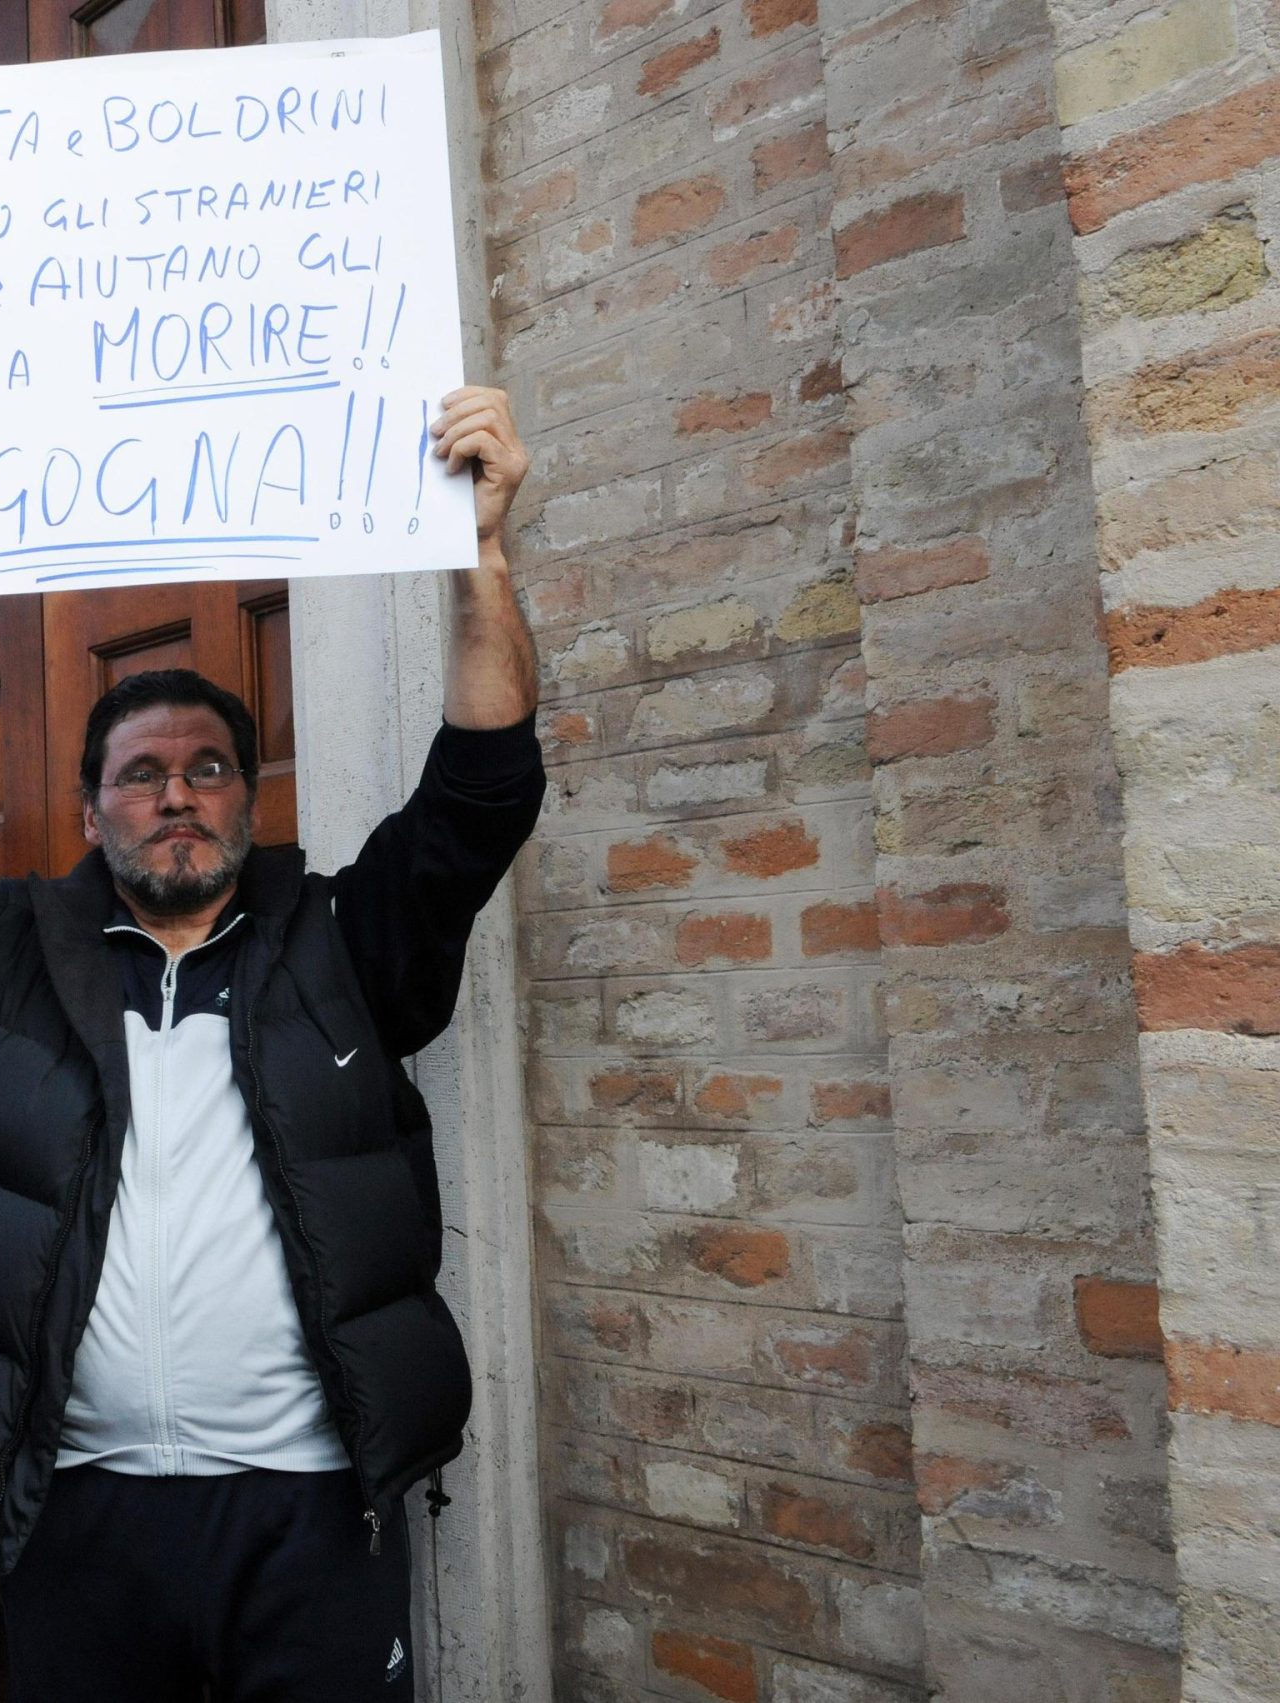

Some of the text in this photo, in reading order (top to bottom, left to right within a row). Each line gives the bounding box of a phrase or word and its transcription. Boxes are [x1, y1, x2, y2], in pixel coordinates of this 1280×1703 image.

[67, 129, 83, 157] e
[103, 84, 386, 152] BOLDRINI
[43, 198, 109, 231] GLI
[134, 170, 381, 225] STRANIERI
[29, 244, 261, 307] AIUTANO
[297, 232, 383, 276] GLI
[8, 349, 31, 391] A
